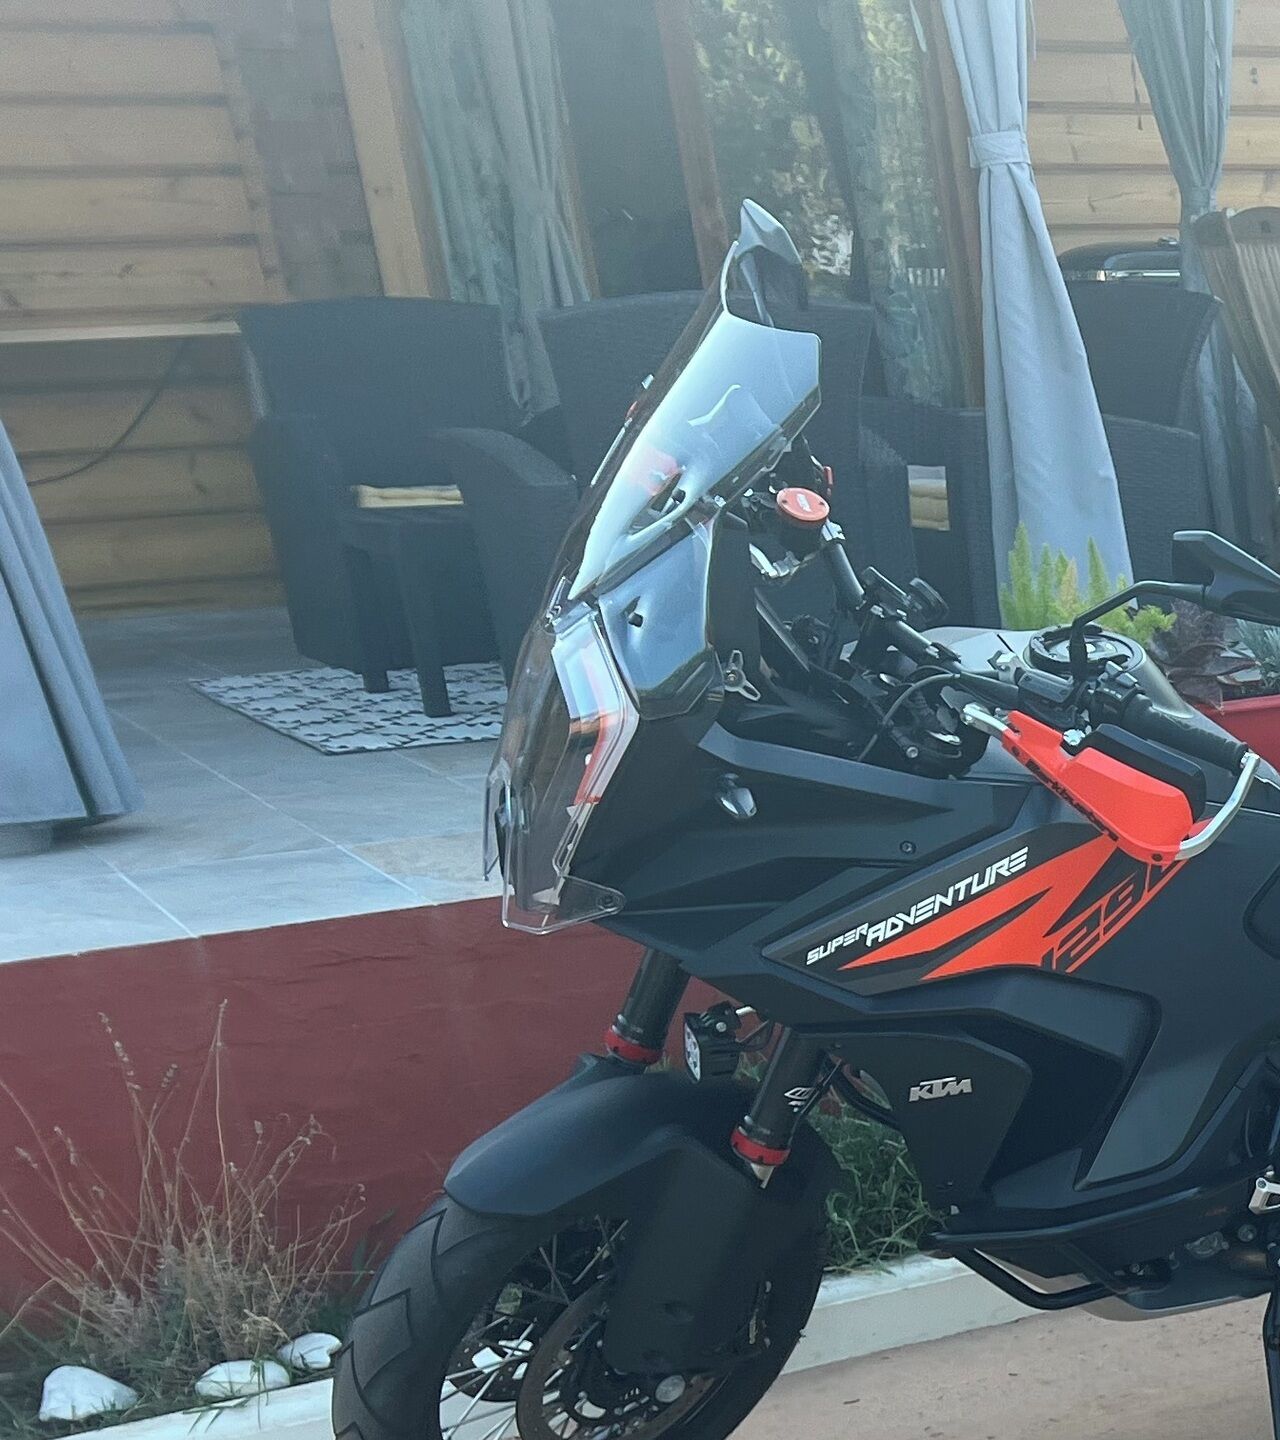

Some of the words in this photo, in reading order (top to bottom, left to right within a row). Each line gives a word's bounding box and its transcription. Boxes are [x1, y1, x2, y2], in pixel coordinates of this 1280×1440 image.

[806, 922, 869, 965] SUPER
[866, 846, 1029, 947] ADVENTURE
[909, 1076, 973, 1102] KTM
